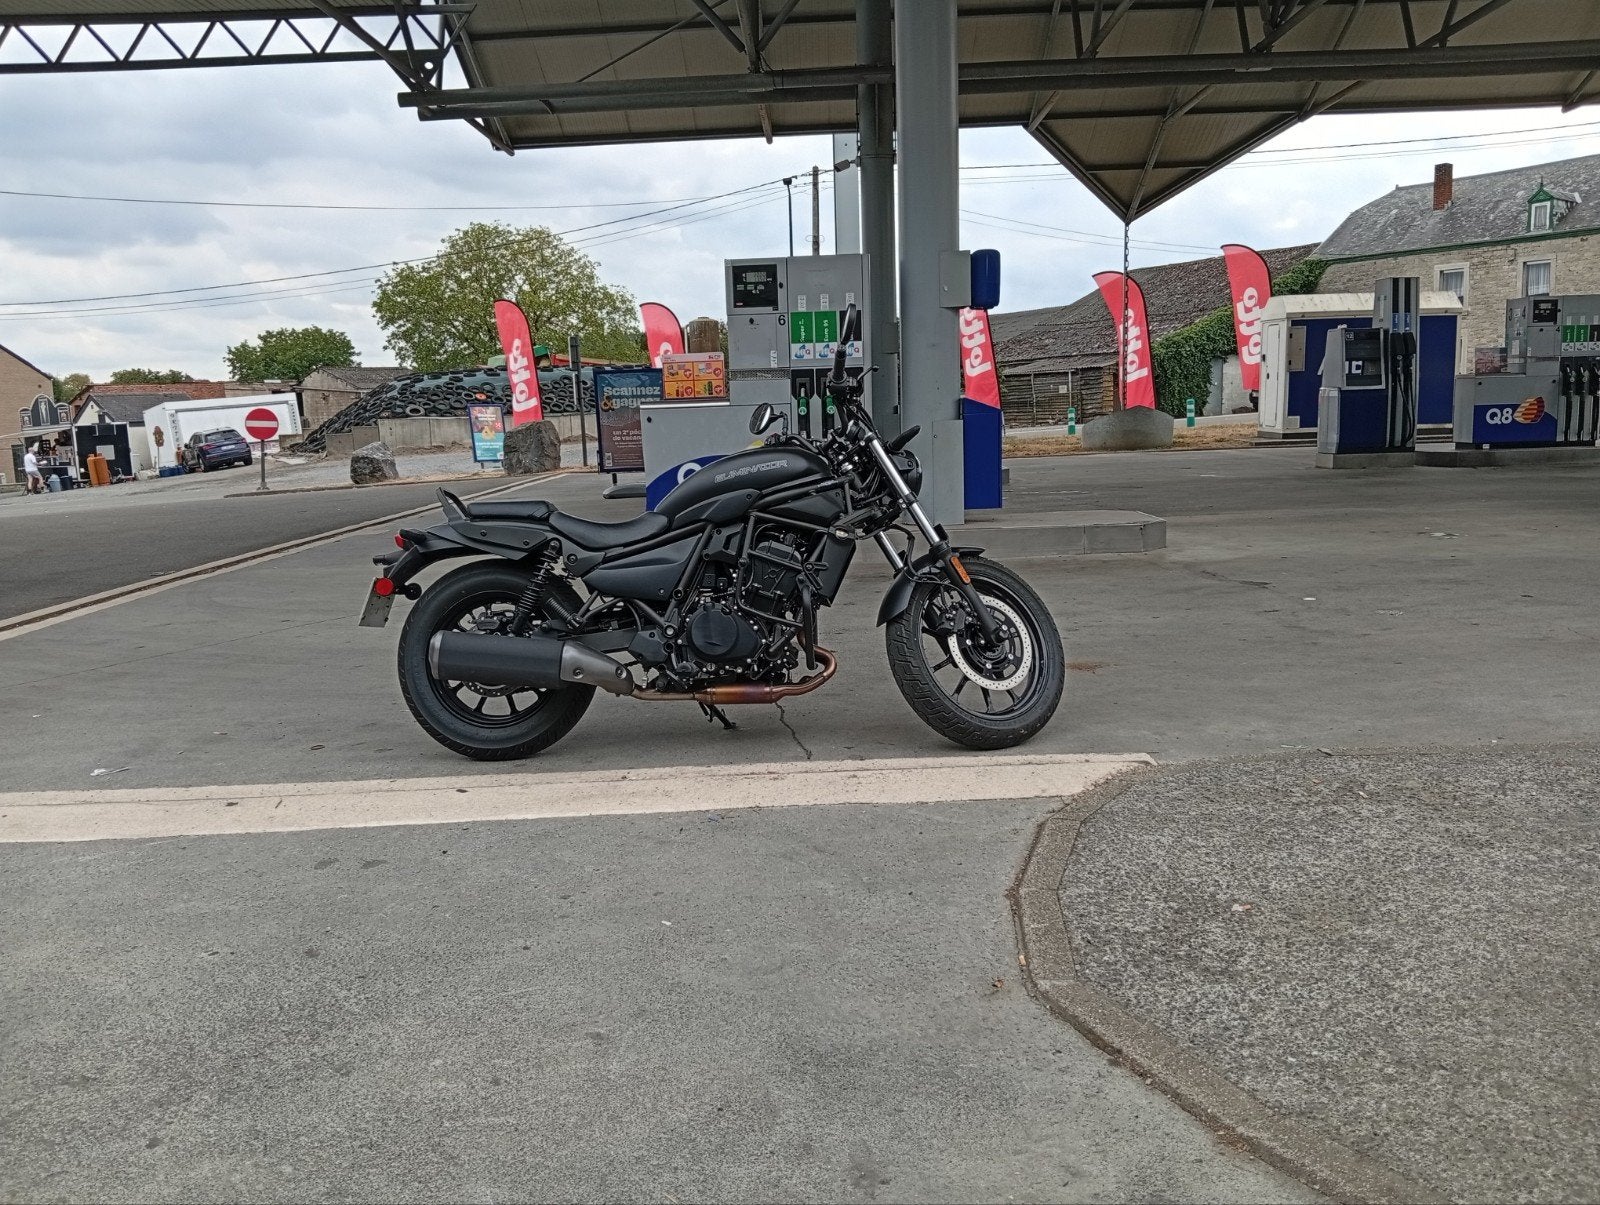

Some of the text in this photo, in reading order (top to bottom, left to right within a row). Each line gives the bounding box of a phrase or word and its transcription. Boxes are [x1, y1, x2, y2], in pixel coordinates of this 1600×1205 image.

[777, 314, 786, 326] 6
[603, 386, 661, 396] Scannez
[1485, 407, 1513, 425] Q8
[714, 459, 788, 483] ELIMINATOR
